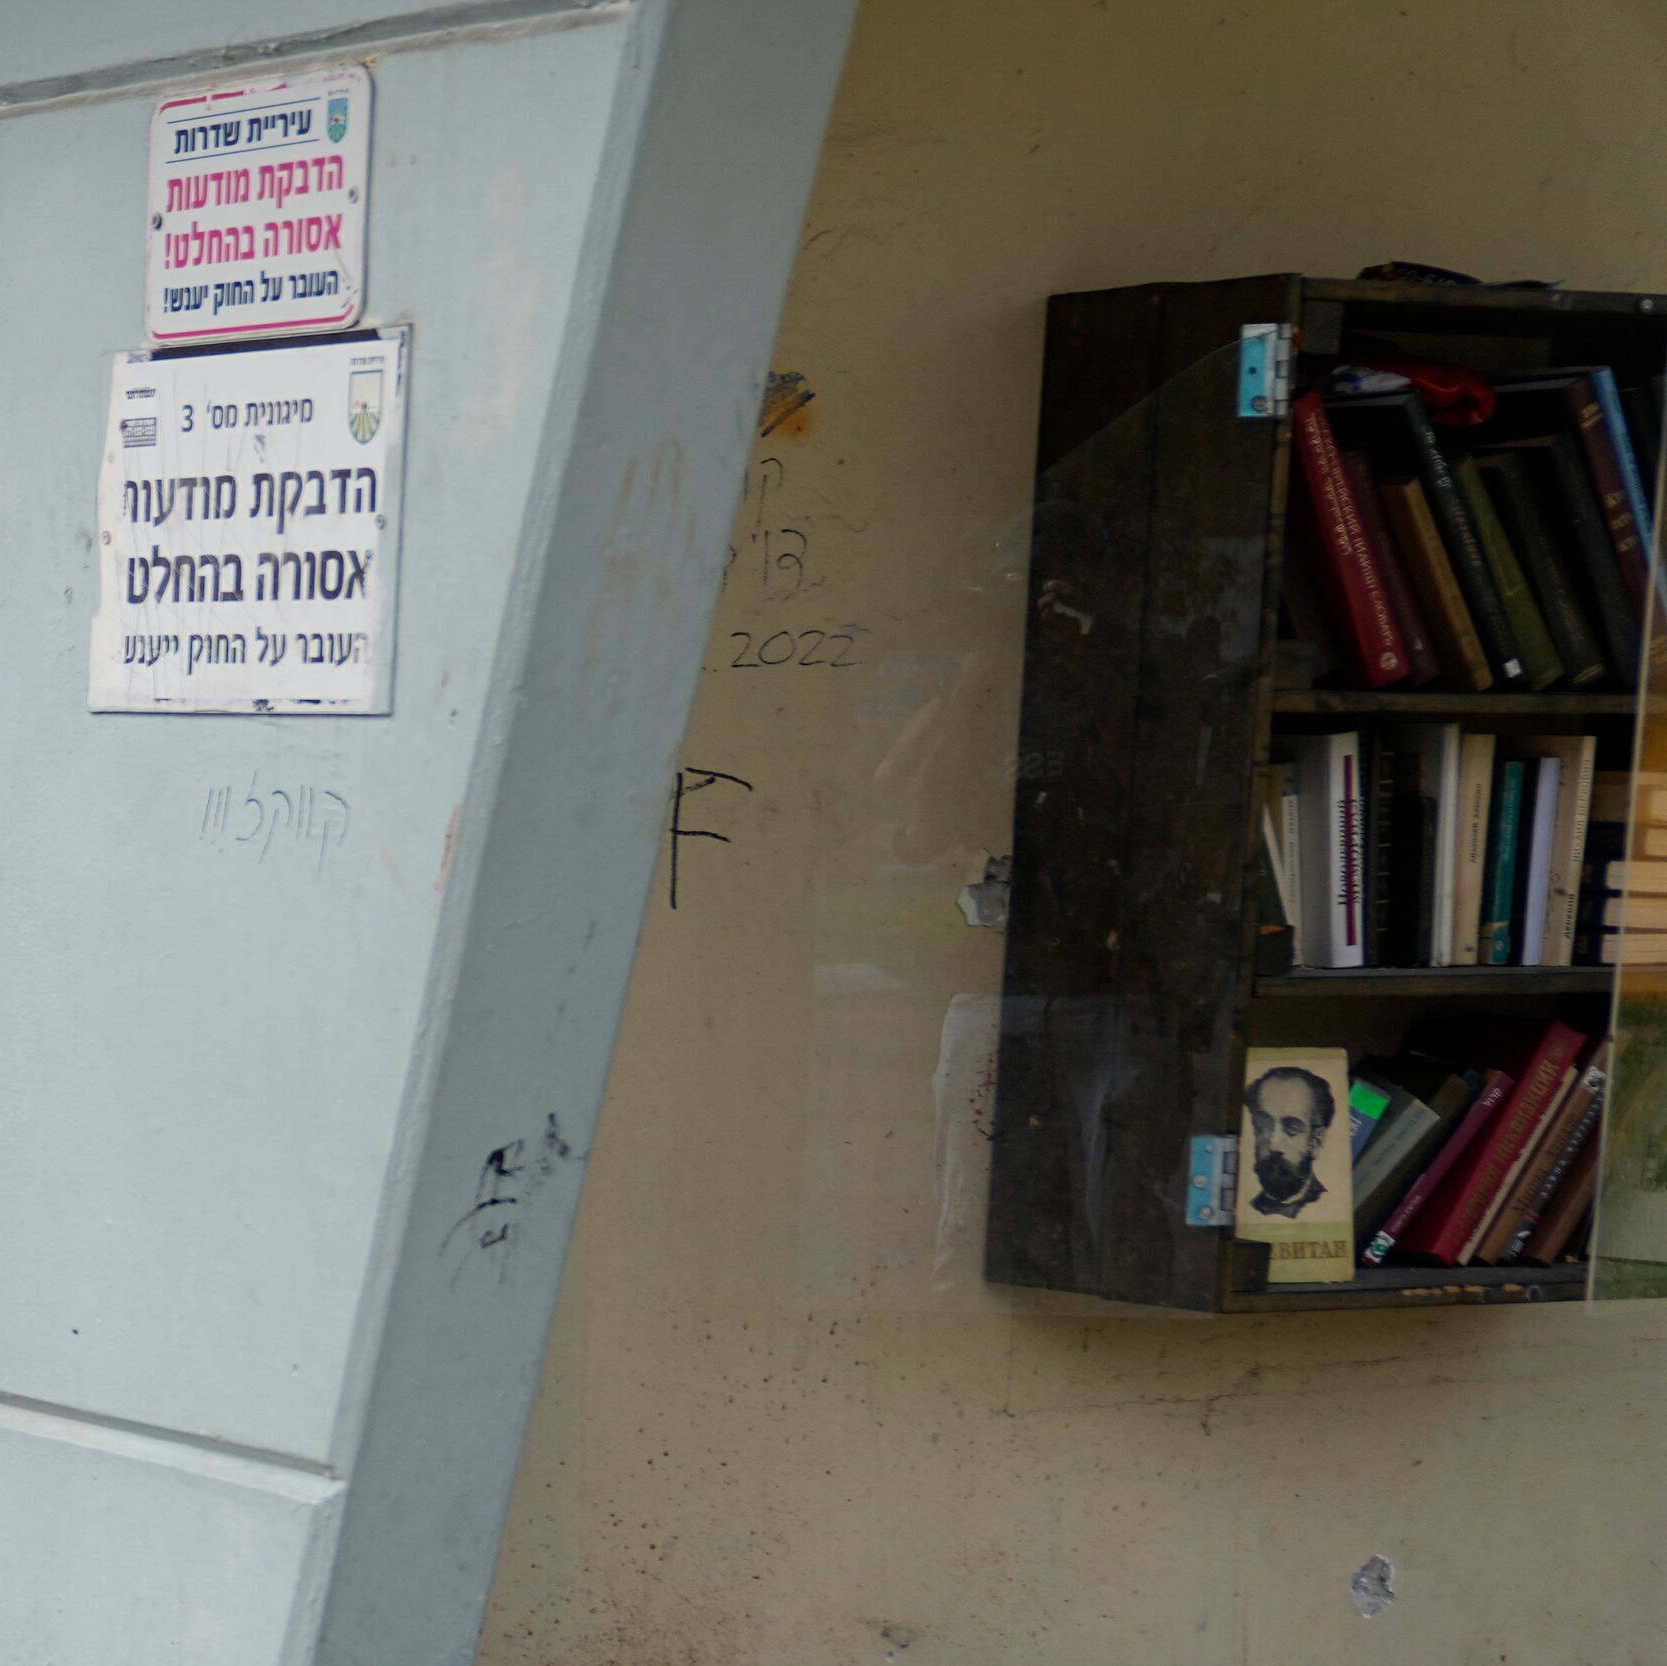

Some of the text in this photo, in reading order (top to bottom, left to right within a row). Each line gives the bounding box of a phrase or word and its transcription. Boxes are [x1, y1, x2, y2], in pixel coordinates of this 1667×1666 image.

[174, 109, 313, 154] עיריית שדרות
[166, 155, 344, 212] הדבקת מודעות
[164, 213, 342, 269] אסורה בהחלט!
[163, 270, 338, 315] העובר על החוק יענש!
[181, 404, 194, 432] 3
[244, 398, 313, 427] מיגונית
[123, 467, 377, 534] הדבקת מודעות
[126, 545, 373, 604] אסורה בהחלט
[187, 633, 246, 675] החוק
[256, 626, 286, 667] על
[296, 631, 367, 667] העובר
[731, 631, 864, 669] 2022
